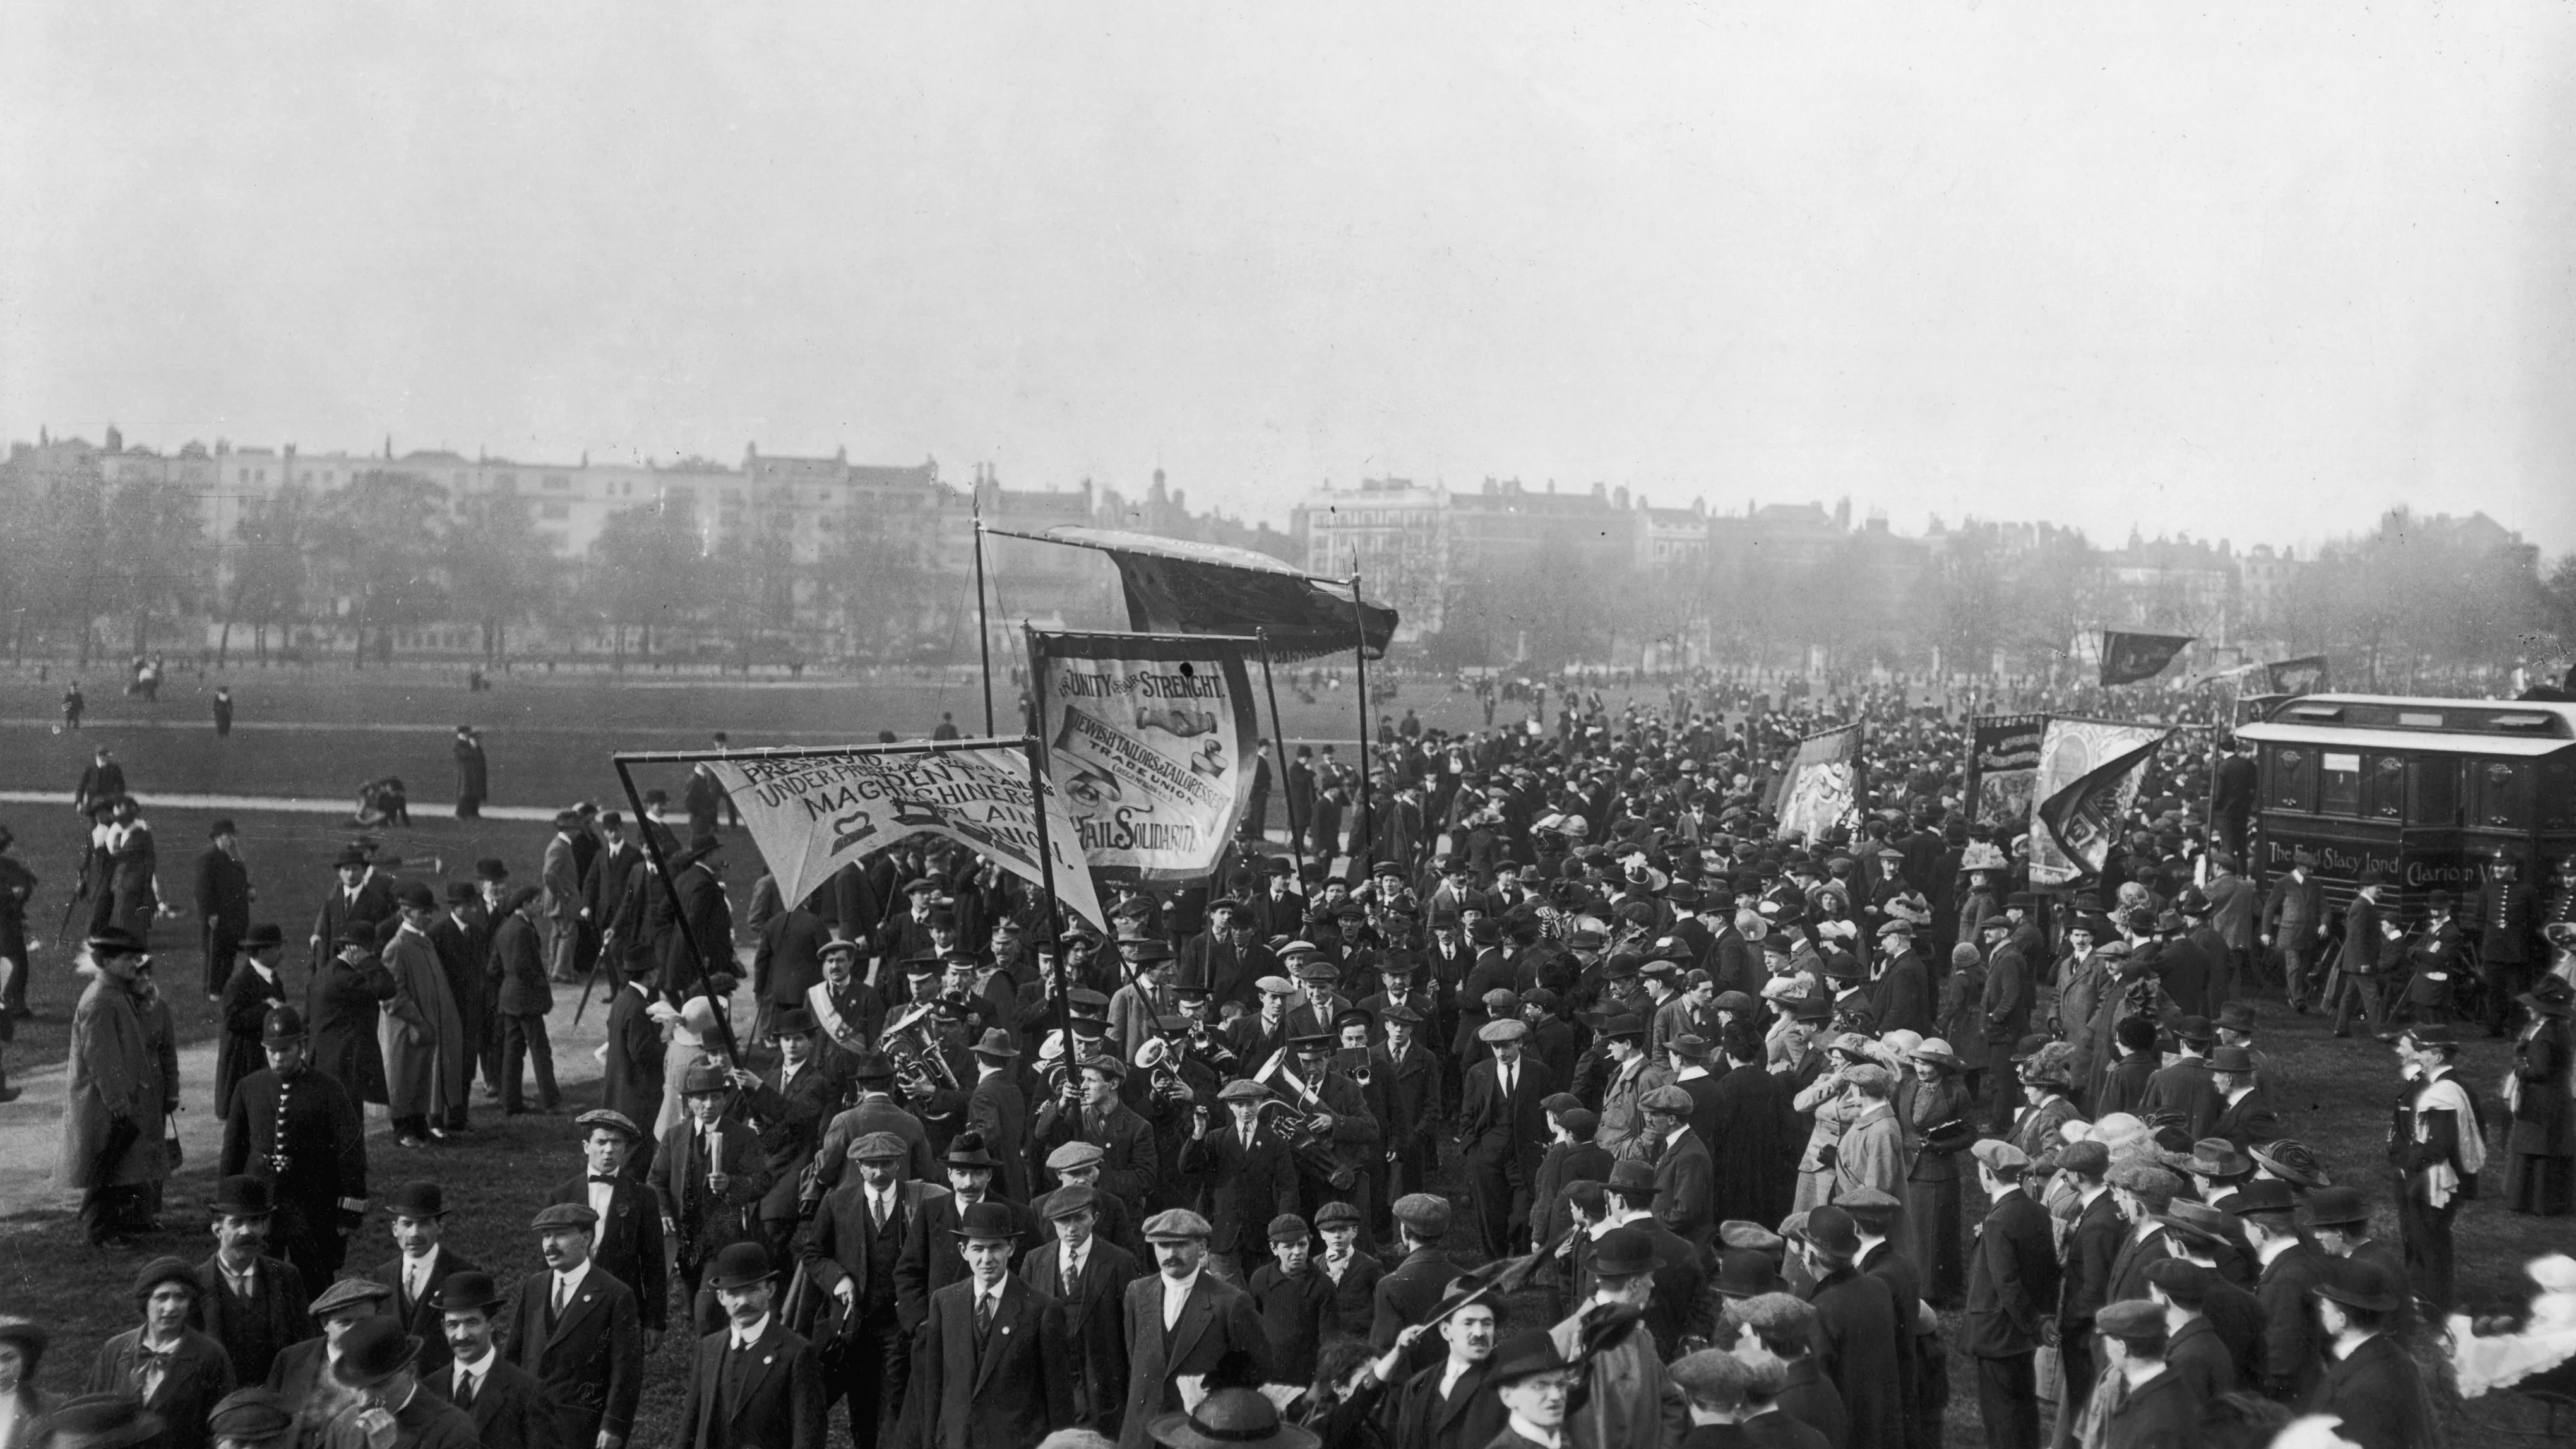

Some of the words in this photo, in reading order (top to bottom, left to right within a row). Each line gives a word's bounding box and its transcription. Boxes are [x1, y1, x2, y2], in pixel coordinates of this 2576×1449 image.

[1066, 669, 1112, 698] UNITY
[1120, 674, 1140, 693] OUR
[1073, 713, 1117, 748] JEWISH
[1088, 739, 1148, 777] TRADE
[1150, 773, 1195, 806] UNION
[2268, 841, 2292, 864] The
[2323, 847, 2362, 874] Stacy
